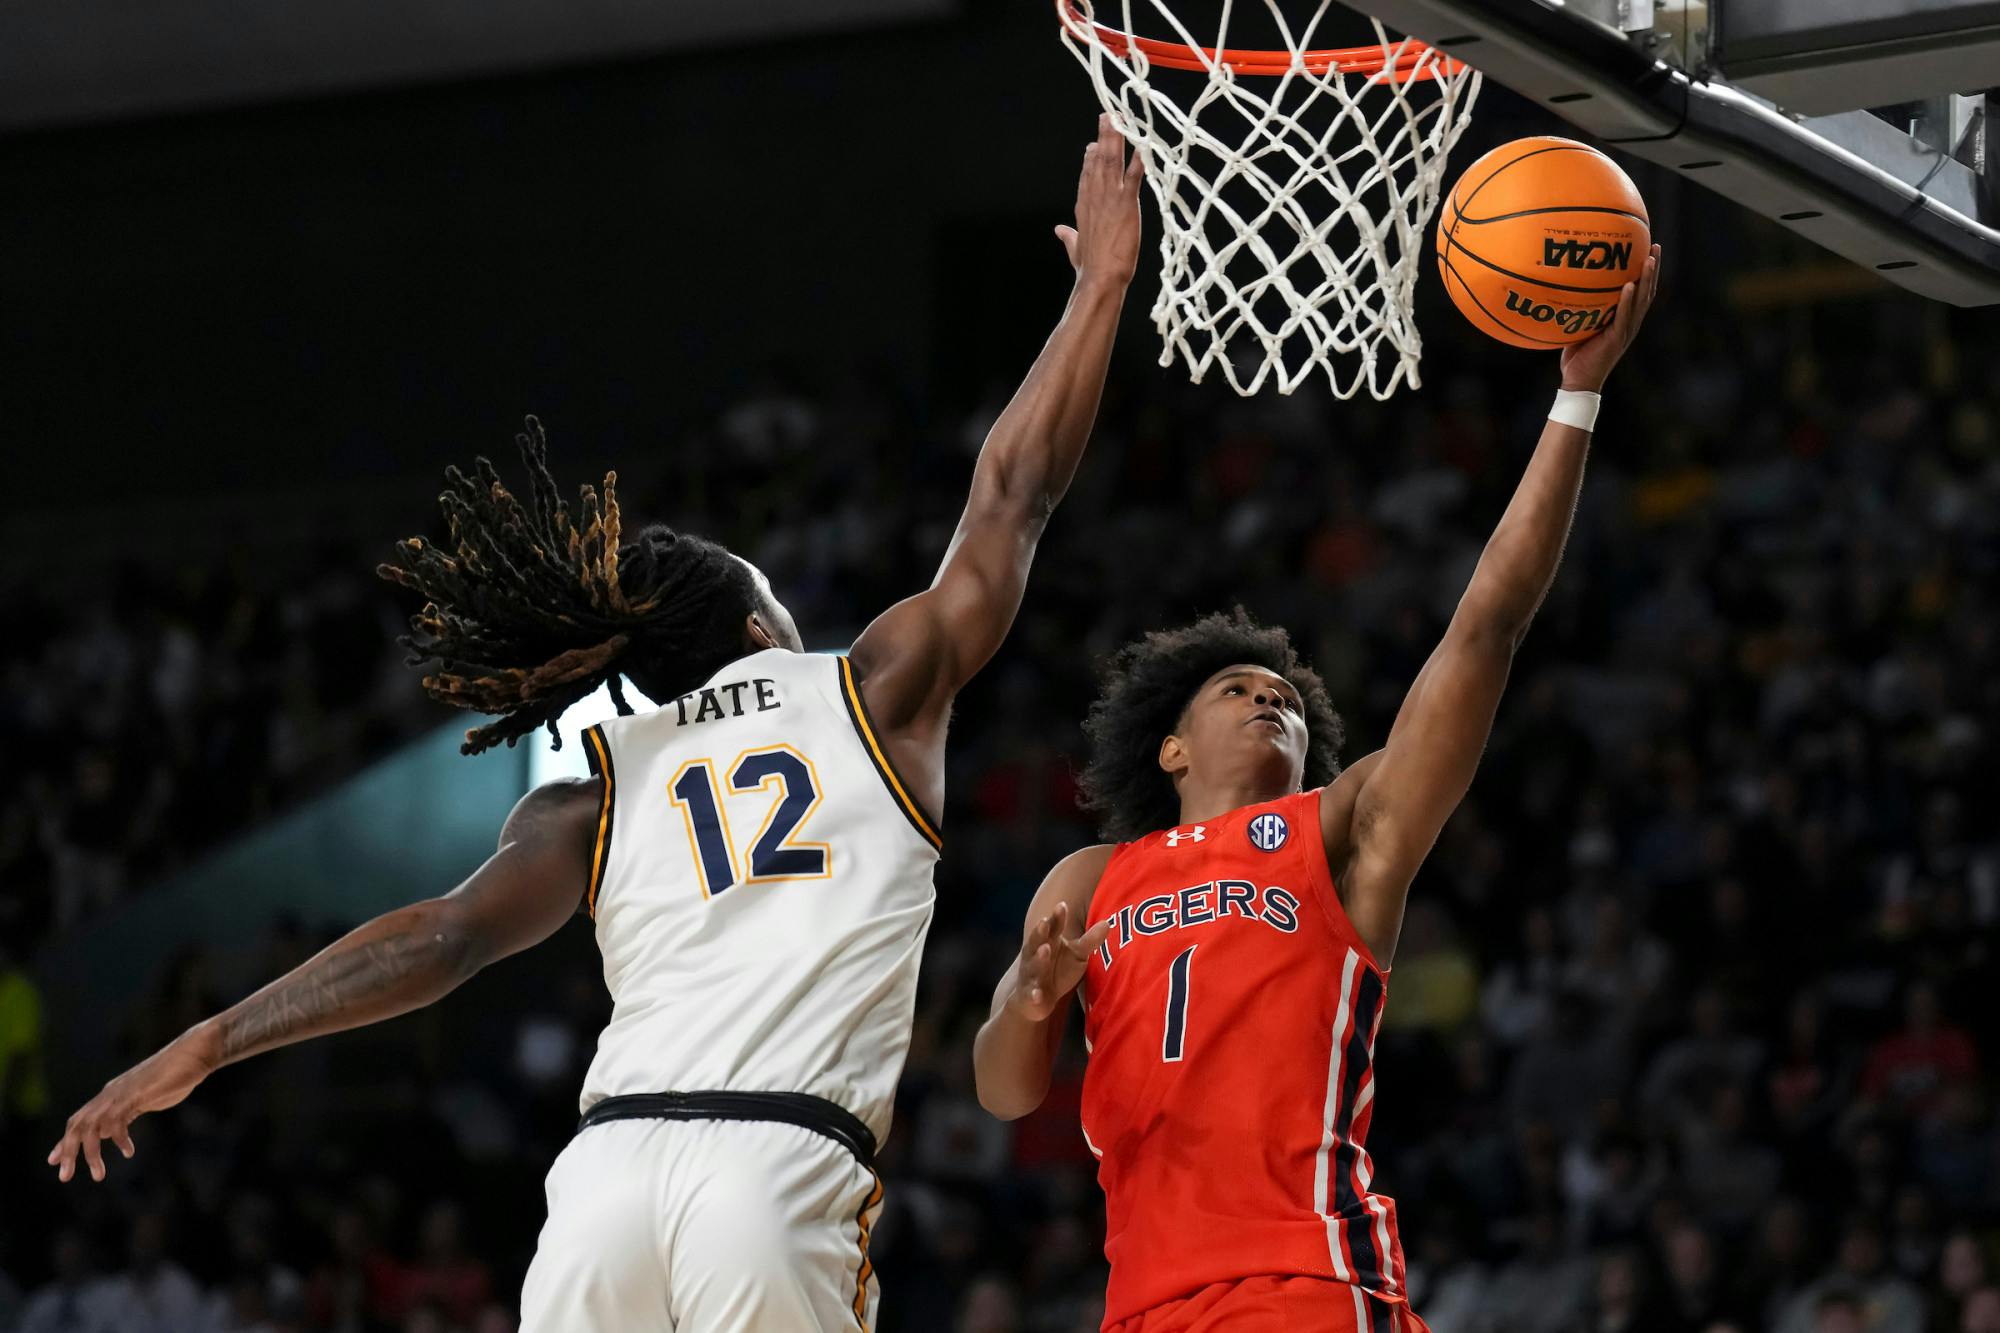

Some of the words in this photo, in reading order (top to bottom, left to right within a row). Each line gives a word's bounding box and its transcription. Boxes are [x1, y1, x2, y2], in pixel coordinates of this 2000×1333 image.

[1544, 228, 1570, 236] BALL
[1544, 239, 1632, 270] NCAA
[675, 679, 781, 726] TATE
[667, 743, 832, 900] 12
[1249, 813, 1287, 850] SEC
[1162, 944, 1199, 1063] 1
